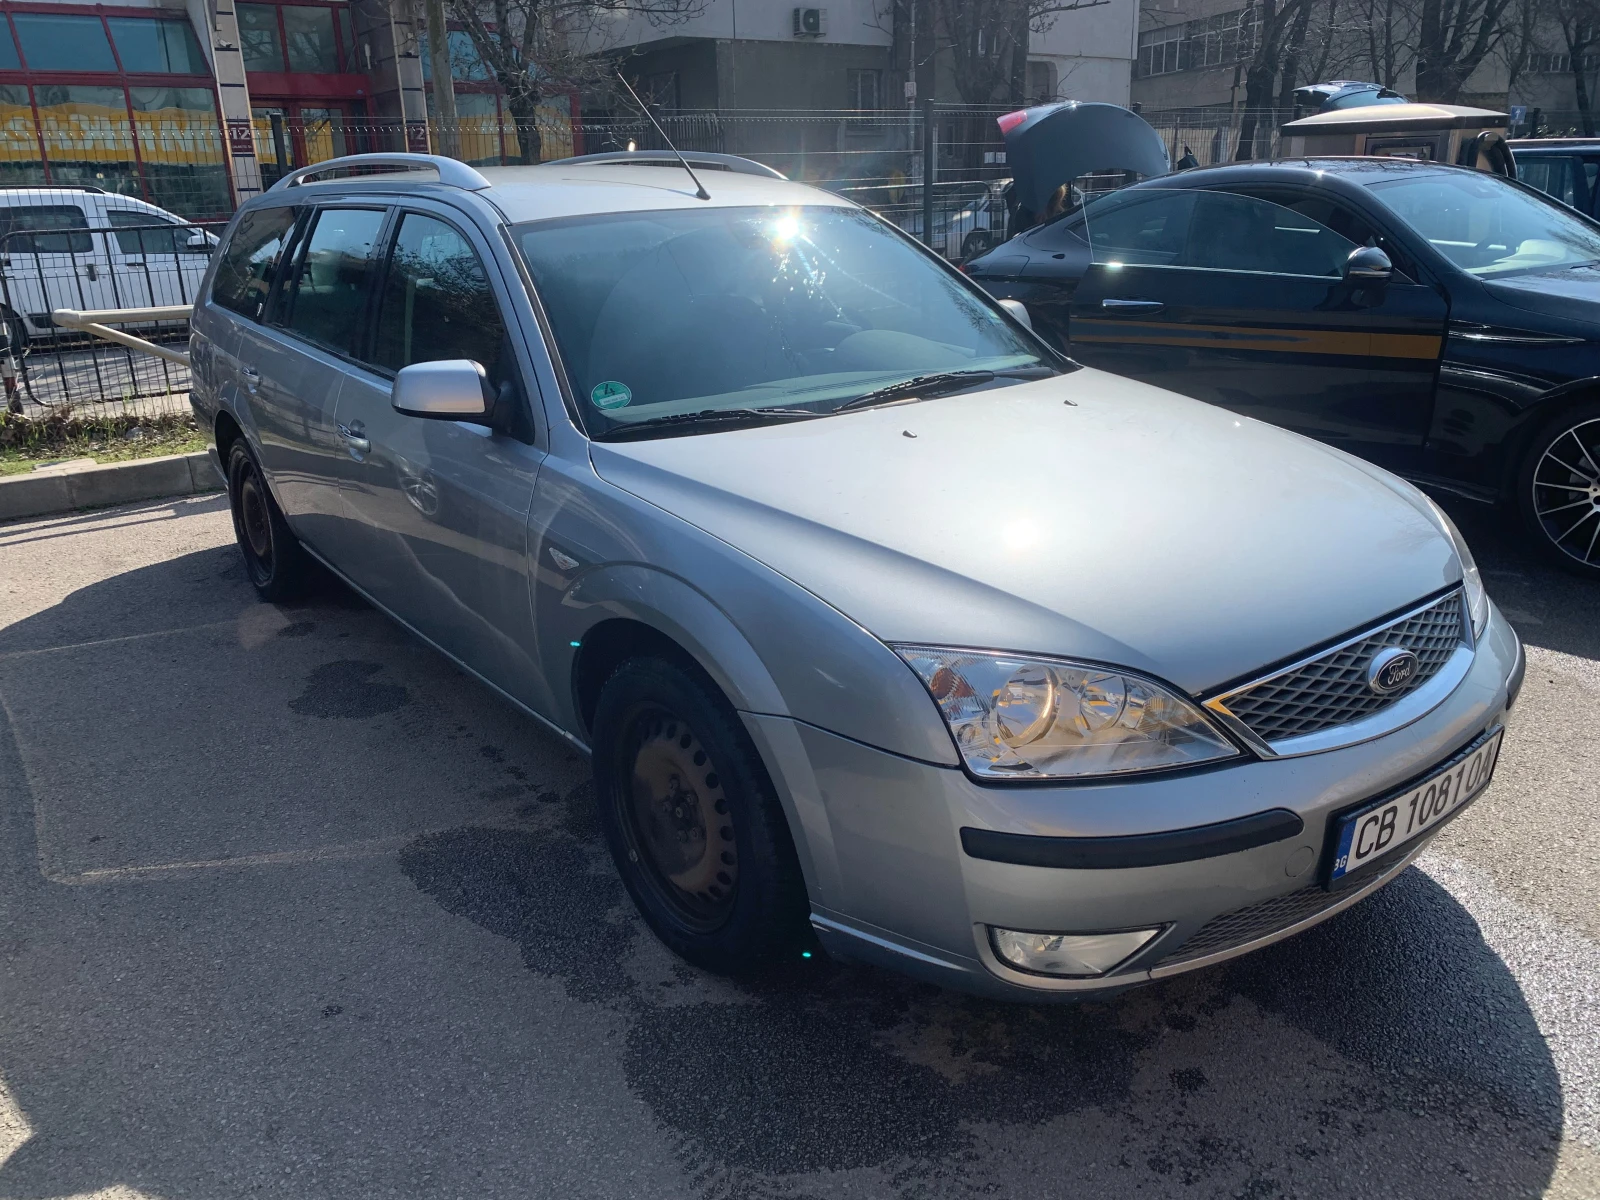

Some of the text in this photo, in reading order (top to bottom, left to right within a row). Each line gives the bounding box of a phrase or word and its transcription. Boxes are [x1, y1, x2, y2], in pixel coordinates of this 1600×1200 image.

[230, 127, 250, 140] 12
[1387, 659, 1411, 685] Ford
[1355, 805, 1398, 859] CB
[1406, 763, 1465, 834] 1081
